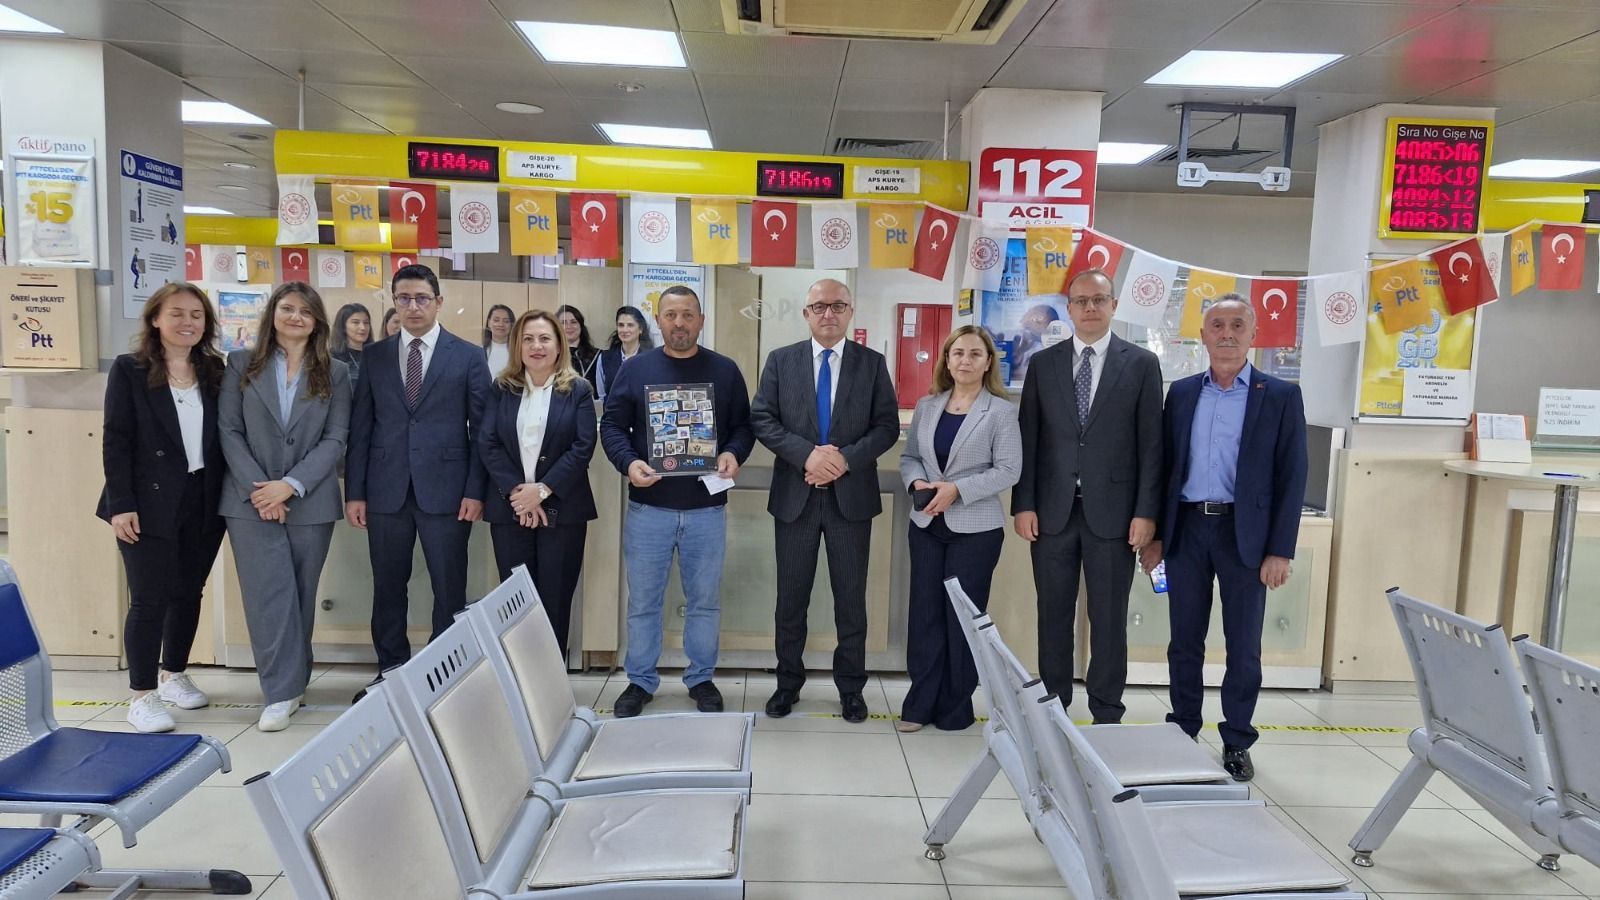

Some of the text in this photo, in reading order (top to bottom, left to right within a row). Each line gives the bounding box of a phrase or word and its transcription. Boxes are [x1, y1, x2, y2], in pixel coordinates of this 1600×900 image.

[1398, 126, 1420, 137] Sıra
[1423, 127, 1439, 137] No
[1469, 129, 1485, 139] No
[53, 142, 86, 153] pano
[992, 158, 1083, 199] 112
[25, 190, 74, 224] %15
[350, 204, 373, 220] Ptt
[527, 214, 550, 230] Ptt
[708, 223, 731, 239] Ptt
[886, 228, 908, 244] Ptt
[256, 260, 270, 270] Ptt
[1045, 252, 1067, 269] Ptt
[364, 264, 378, 275] Ptt
[10, 294, 31, 302] ÖNERİ
[40, 296, 65, 304] ŞİKAYET
[1395, 286, 1420, 306] Ptt
[31, 332, 54, 348] Ptt
[1398, 333, 1437, 360] GB
[693, 458, 705, 466] Ptt
